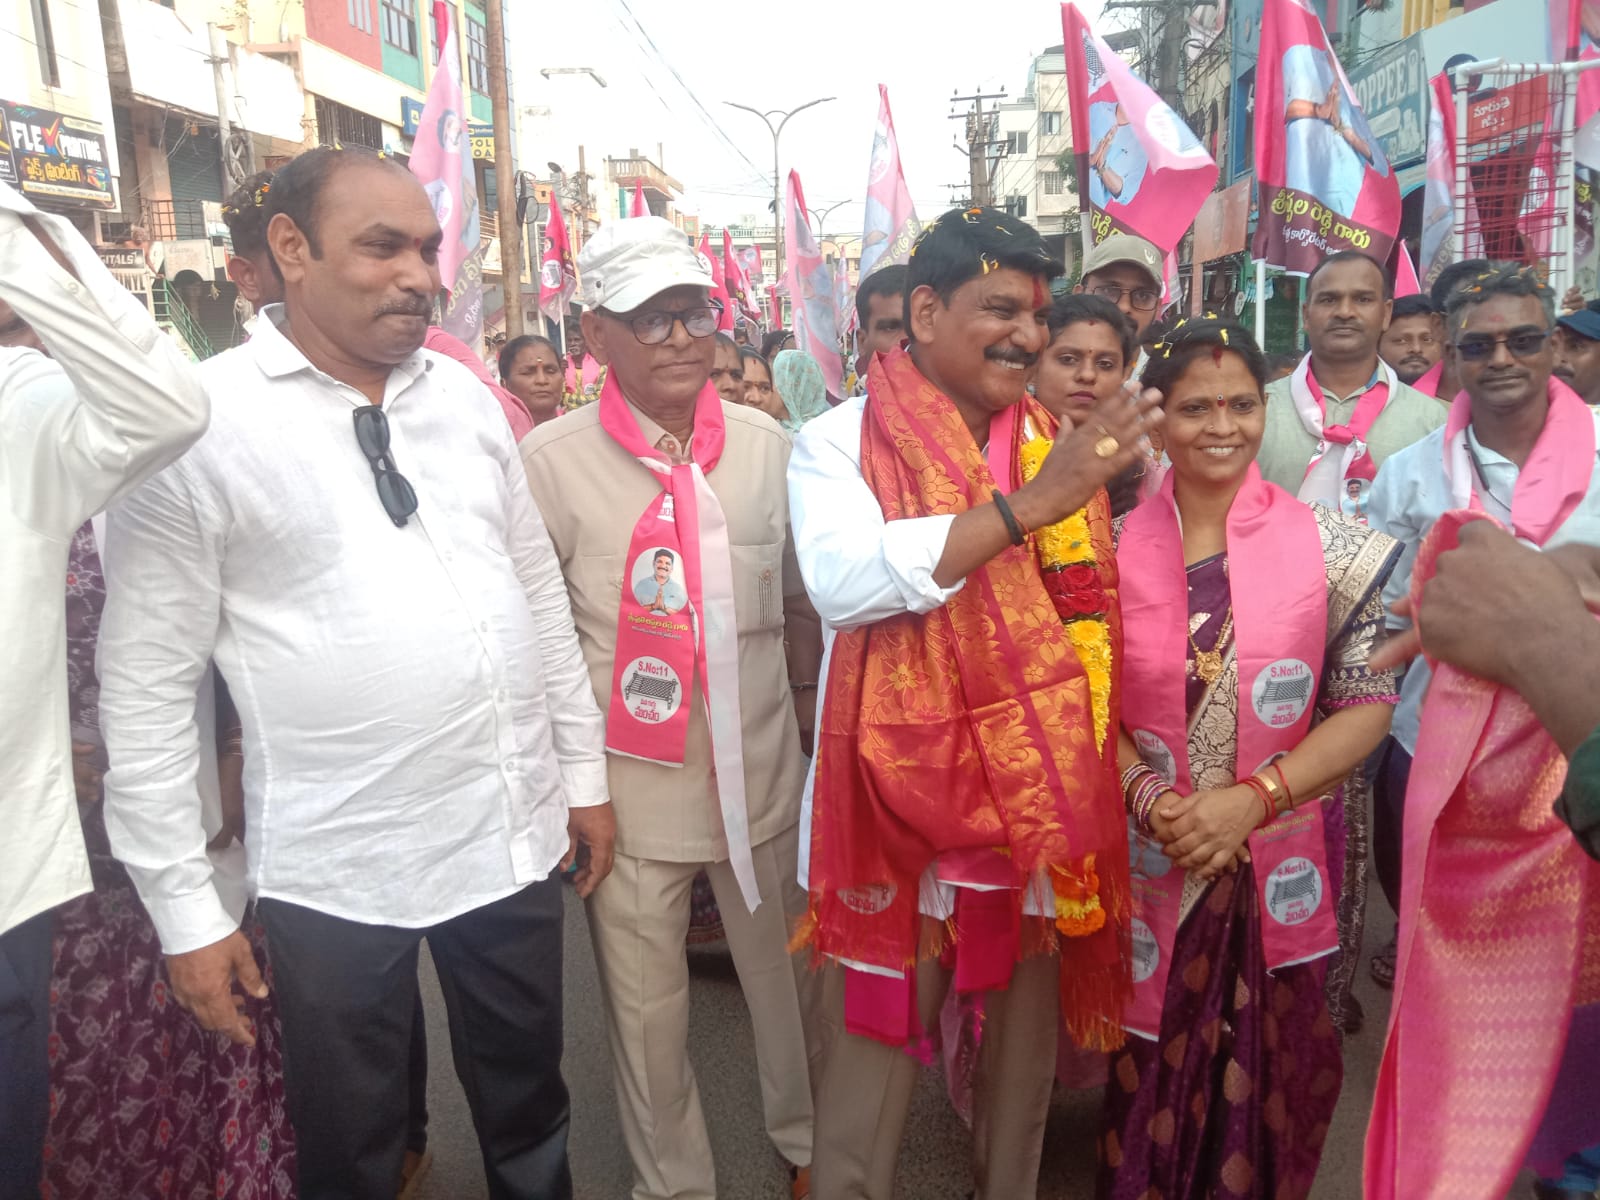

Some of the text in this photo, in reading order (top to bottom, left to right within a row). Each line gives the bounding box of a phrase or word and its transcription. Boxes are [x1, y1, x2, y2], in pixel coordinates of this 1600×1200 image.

[1354, 55, 1407, 115] OPPEE
[10, 118, 59, 156] FLEX
[474, 149, 493, 158] OA
[638, 661, 668, 677] S.No:11
[1270, 664, 1304, 678] S.No:11
